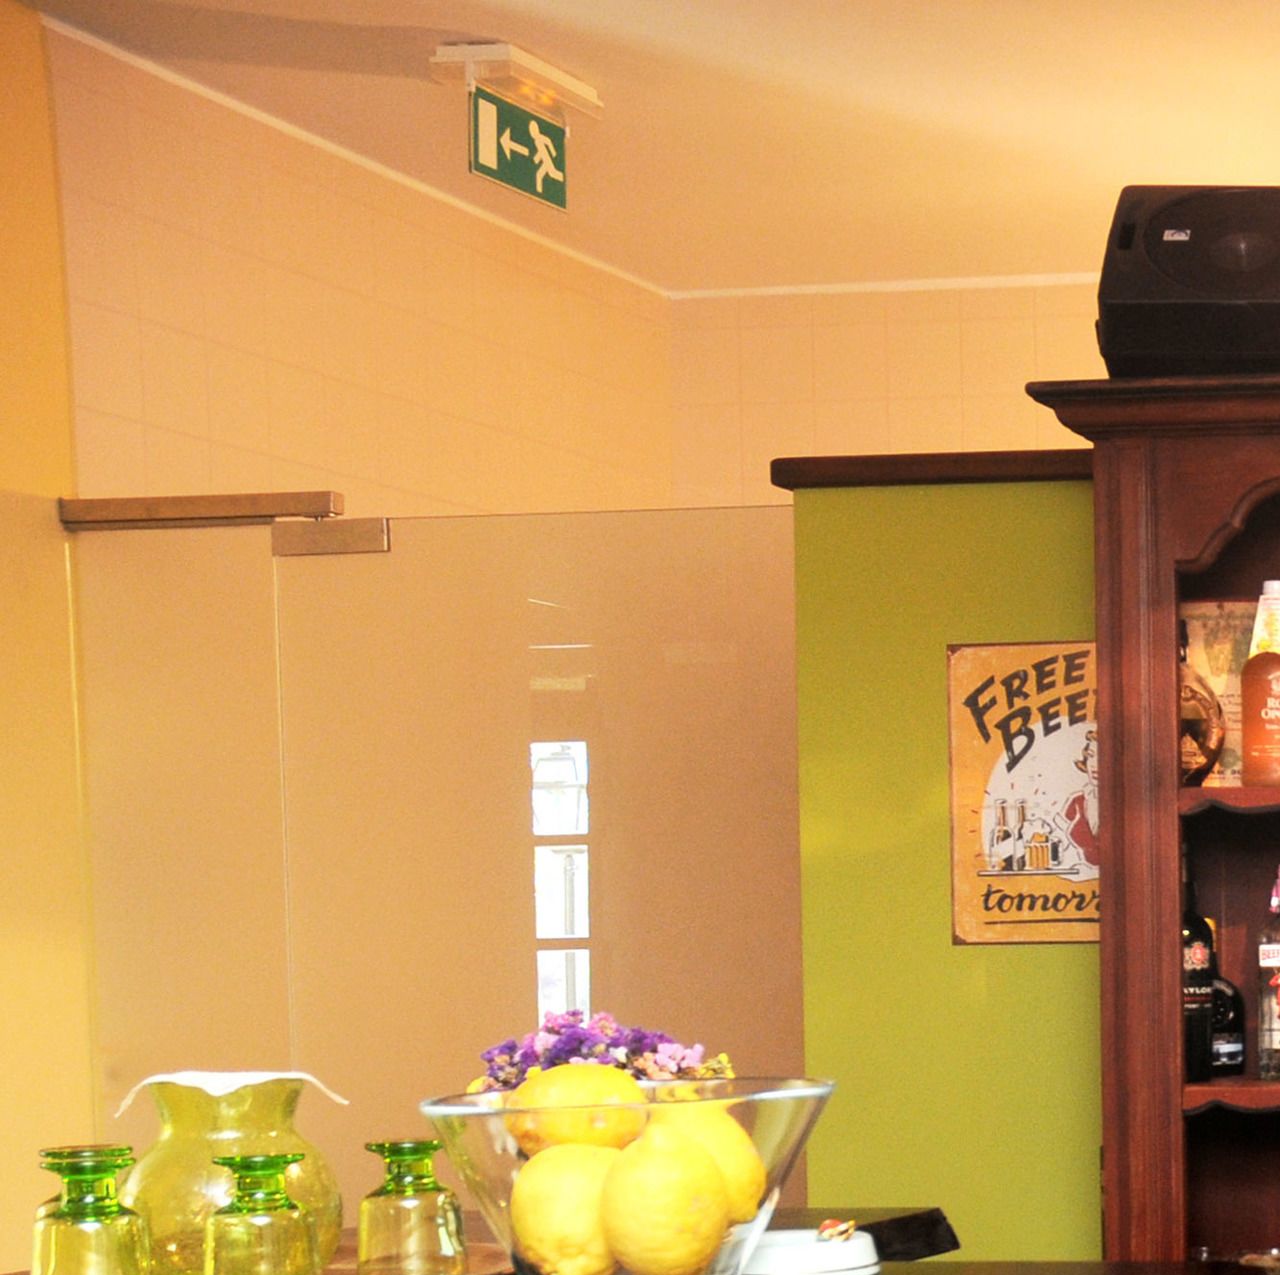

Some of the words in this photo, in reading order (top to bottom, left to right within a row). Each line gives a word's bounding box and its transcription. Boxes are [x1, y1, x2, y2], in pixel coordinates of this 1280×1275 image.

[963, 650, 1090, 743] FREE
[994, 688, 1097, 773] BEE
[981, 884, 1100, 912] tomorr
